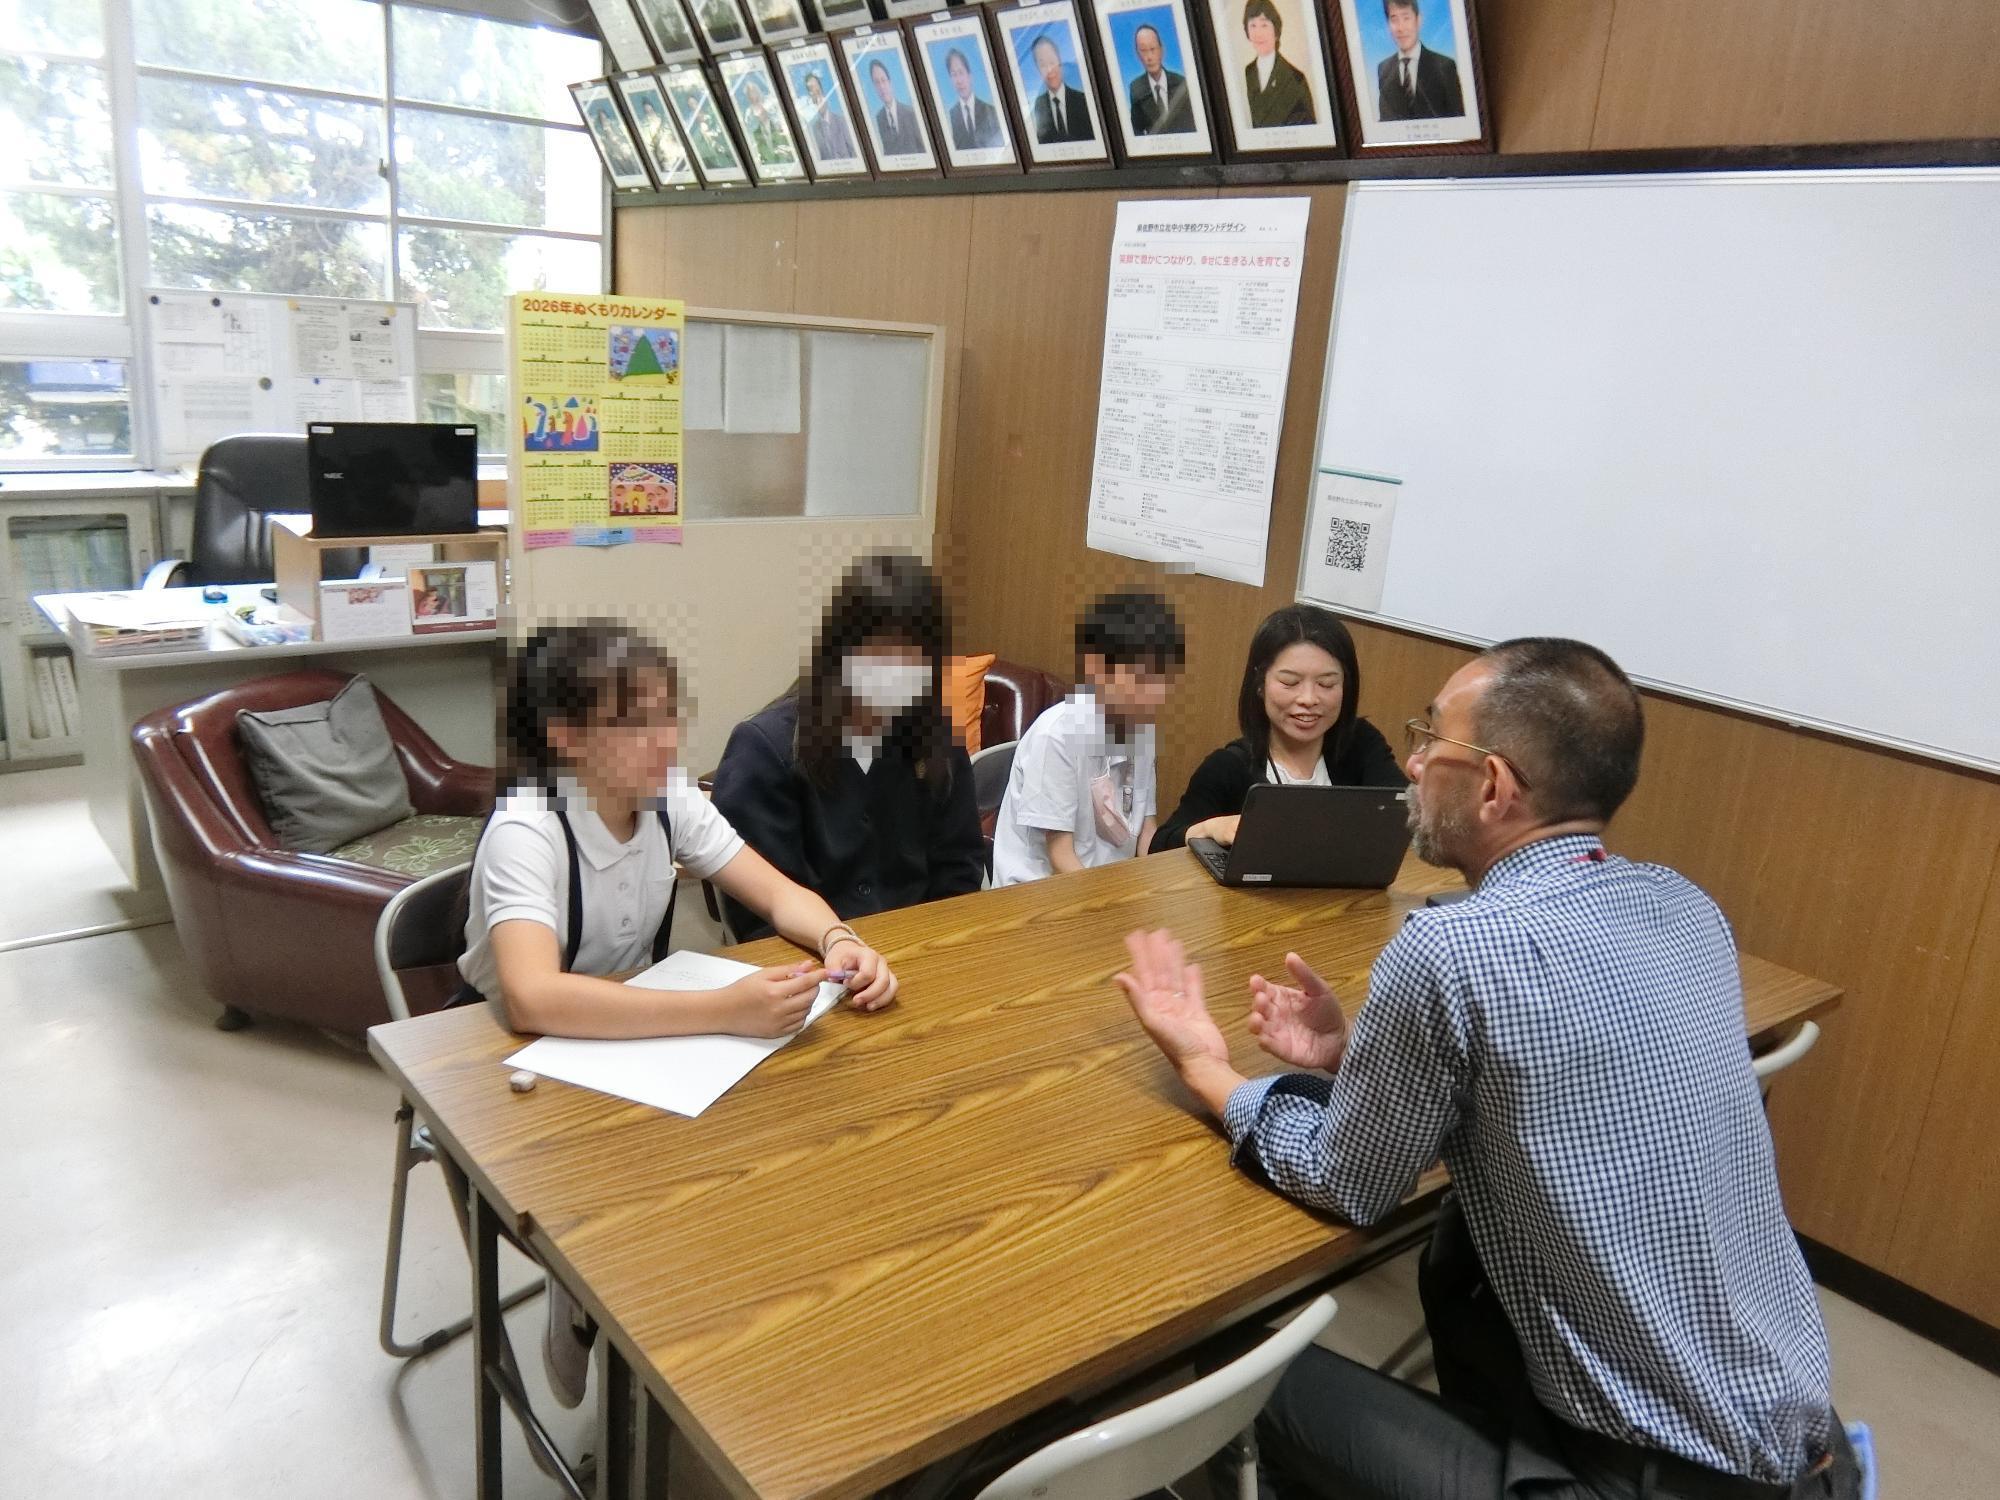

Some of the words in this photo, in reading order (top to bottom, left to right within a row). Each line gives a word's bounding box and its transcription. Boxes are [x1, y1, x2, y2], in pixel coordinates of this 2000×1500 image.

[523, 298, 677, 320] 2026年ぬくもりカレンダー
